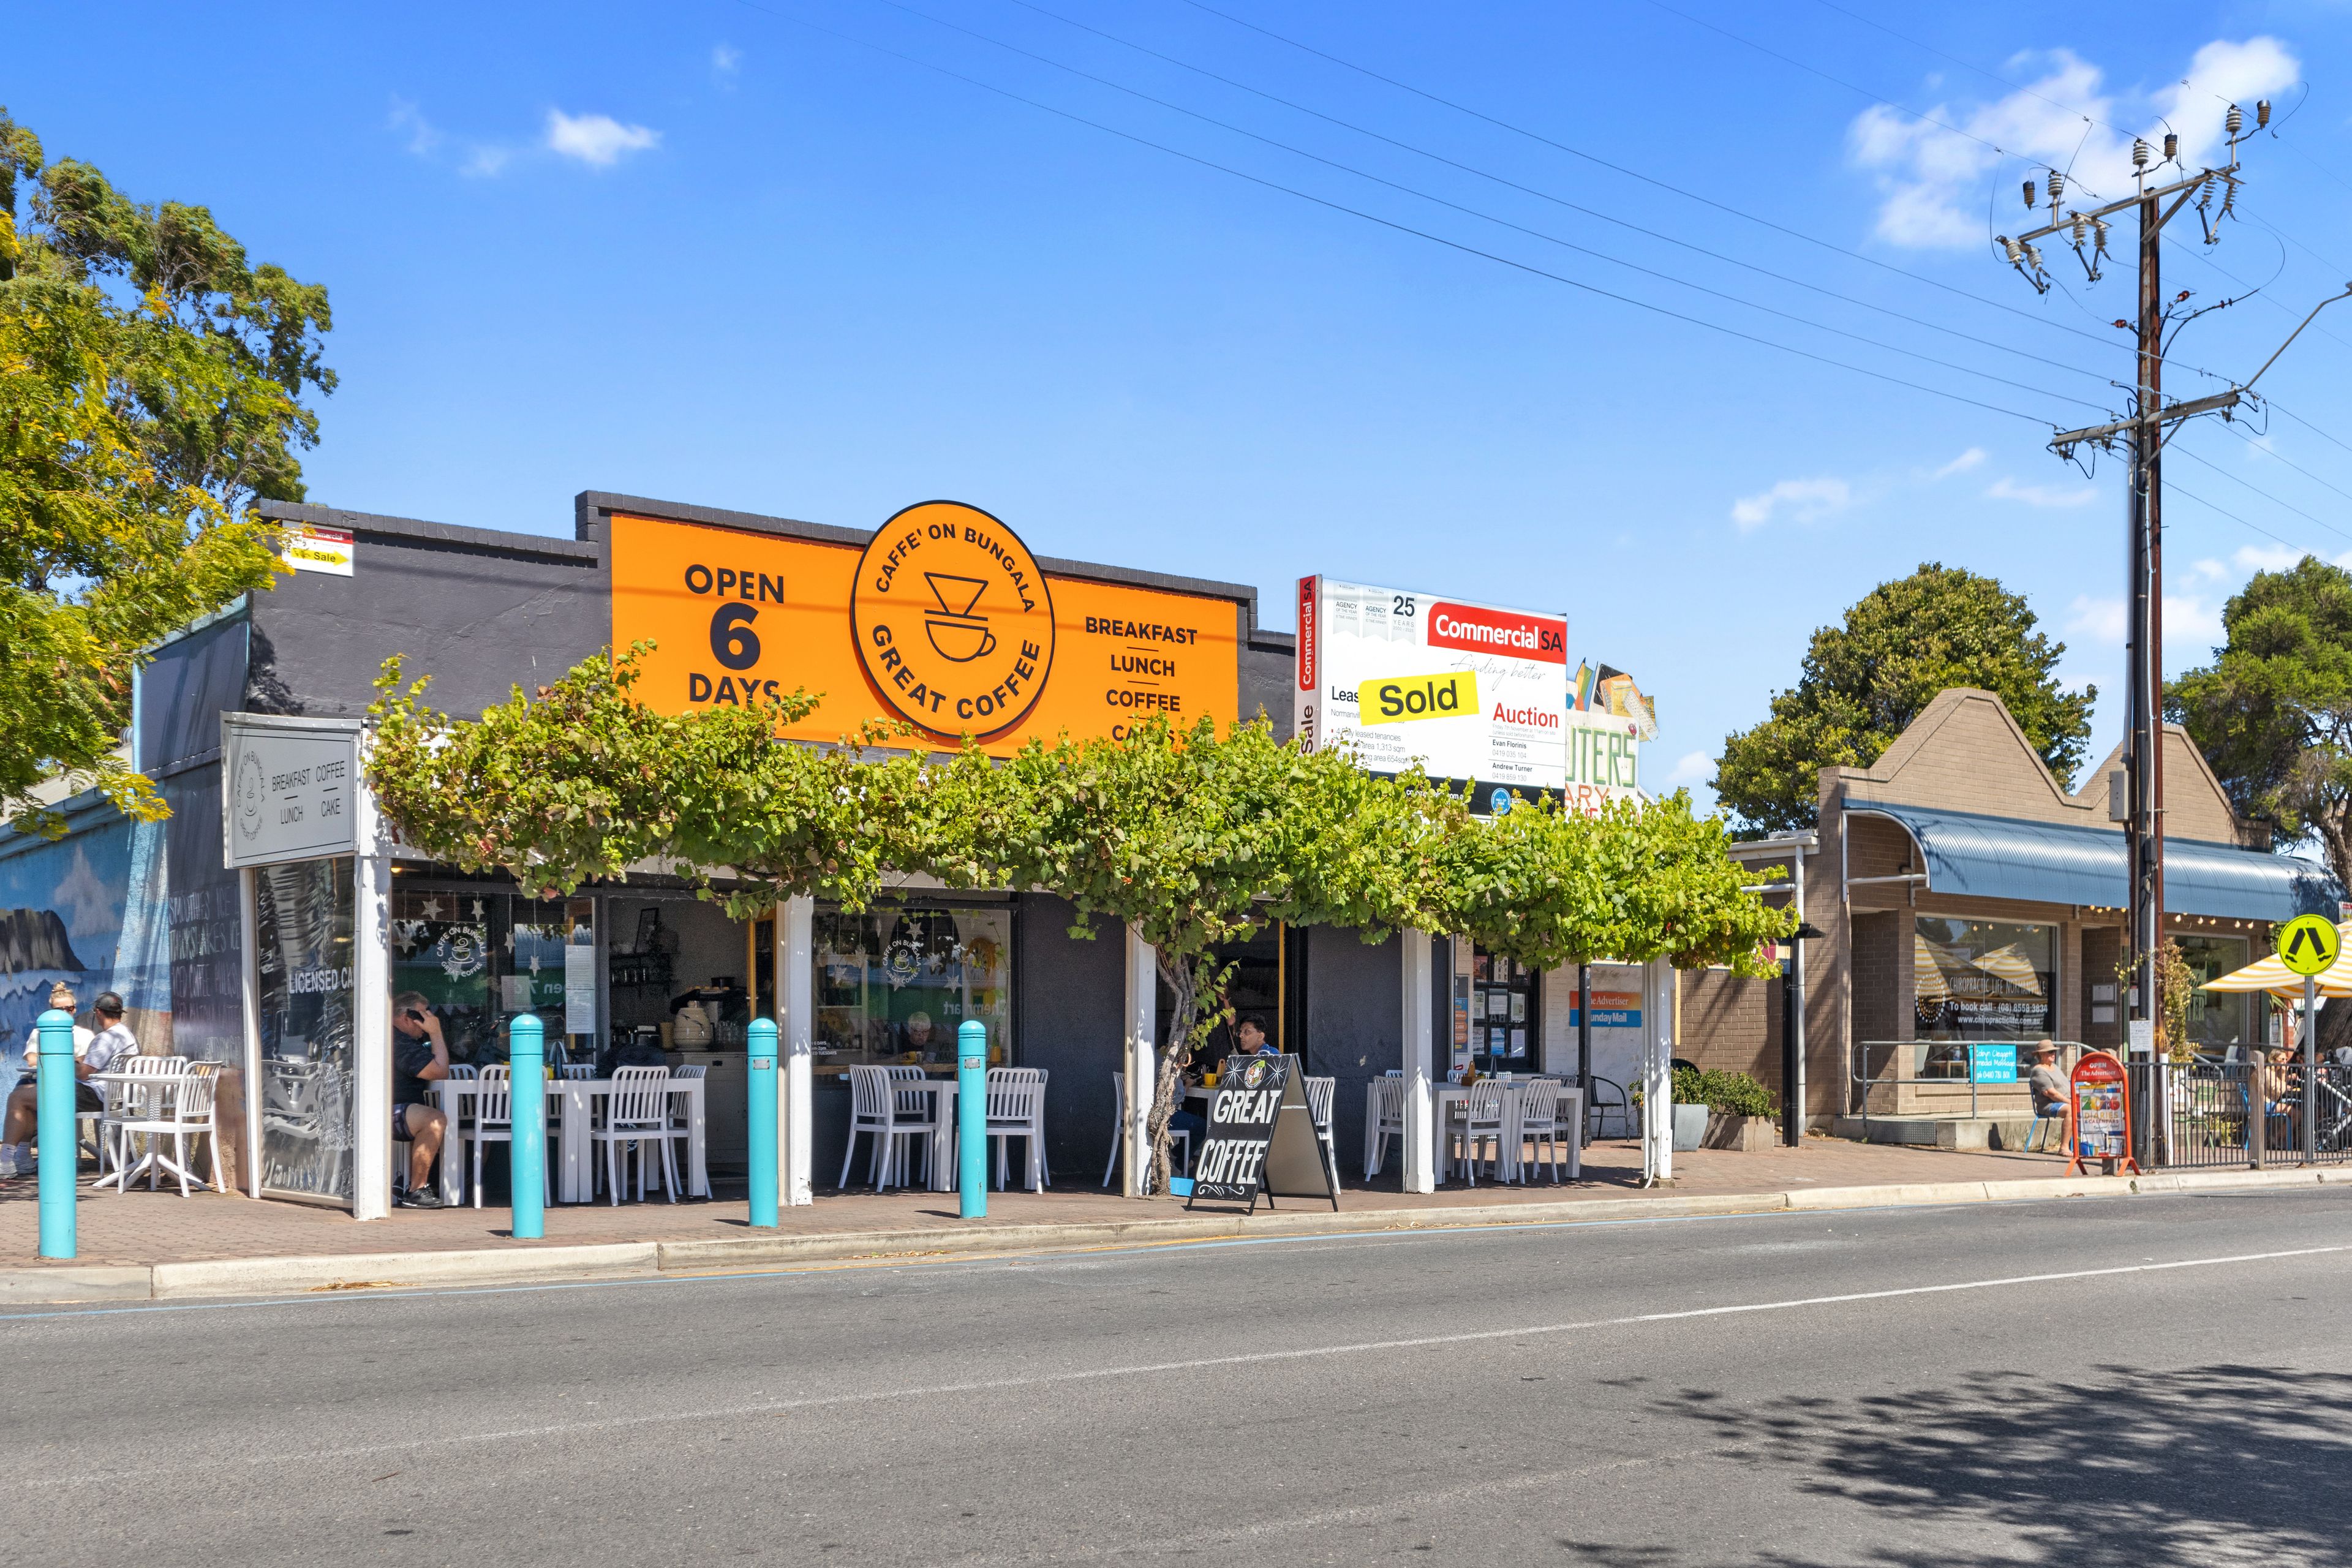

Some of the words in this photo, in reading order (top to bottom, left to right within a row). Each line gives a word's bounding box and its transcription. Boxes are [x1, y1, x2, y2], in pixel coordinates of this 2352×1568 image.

[314, 552, 336, 562] Sale
[929, 524, 956, 540] ON
[964, 527, 1035, 613] BUNGALA
[685, 564, 784, 604] OPEN
[1304, 580, 1312, 601] SA
[1366, 605, 1387, 614] AGENCY
[1393, 595, 1415, 617] 25
[709, 602, 761, 671] 6
[1085, 616, 1197, 645] BREAKFAST
[1436, 614, 1538, 649] Commercial
[1541, 630, 1563, 652] SA
[1303, 601, 1311, 685] Commercial
[872, 624, 946, 714] GREAT
[956, 639, 1040, 720] COFFEE
[1110, 654, 1175, 677] LUNCH
[1450, 654, 1507, 691] finding
[1510, 661, 1546, 680] better
[689, 673, 781, 707] DAYS
[1106, 689, 1180, 712] COFFEE
[1332, 686, 1359, 703] Leas
[1379, 679, 1458, 717] Sold
[1331, 709, 1360, 719] Normanvill
[1493, 702, 1558, 728] Auction
[1301, 705, 1313, 755] Sale
[1355, 729, 1373, 739] leased
[1375, 732, 1401, 741] tenancies
[244, 752, 250, 766] ON
[1566, 725, 1636, 788] UTERS
[272, 769, 311, 791] BREAKFAST
[316, 761, 344, 783] COFFEE
[1565, 783, 1610, 807] ARY
[281, 805, 303, 824] LUNCH
[321, 798, 341, 818] CAKE
[437, 932, 450, 957] CAFFE
[462, 927, 486, 957] BUNGALA
[883, 944, 893, 966] CAFFE
[903, 940, 921, 967] BUNGALA
[441, 961, 459, 976] GREAT
[461, 962, 483, 977] COFFEE
[886, 970, 900, 982] GREAT
[902, 971, 919, 984] COFFEE
[289, 969, 337, 994] LICENSED
[341, 967, 353, 989] CA
[1950, 976, 1989, 993] CHIROPRACTIC
[1992, 979, 2003, 993] LIFE
[2006, 980, 2046, 995] NORMANVILLE
[1596, 996, 1629, 1005] Advertiser
[1950, 1002, 1959, 1011] To
[1961, 1002, 1978, 1011] book
[1980, 1002, 1992, 1011] call
[1998, 1003, 2011, 1014] (08)
[2013, 1003, 2029, 1013] 8558
[1591, 1012, 1612, 1024] unday
[1612, 1012, 1627, 1022] Mail
[1958, 1016, 2040, 1025] www.chiropracticlife.com.au
[1994, 1059, 2015, 1071] Massage
[1213, 1090, 1283, 1124] GREAT
[2081, 1095, 2120, 1111] 2026
[1196, 1139, 1268, 1184] COFFEE
